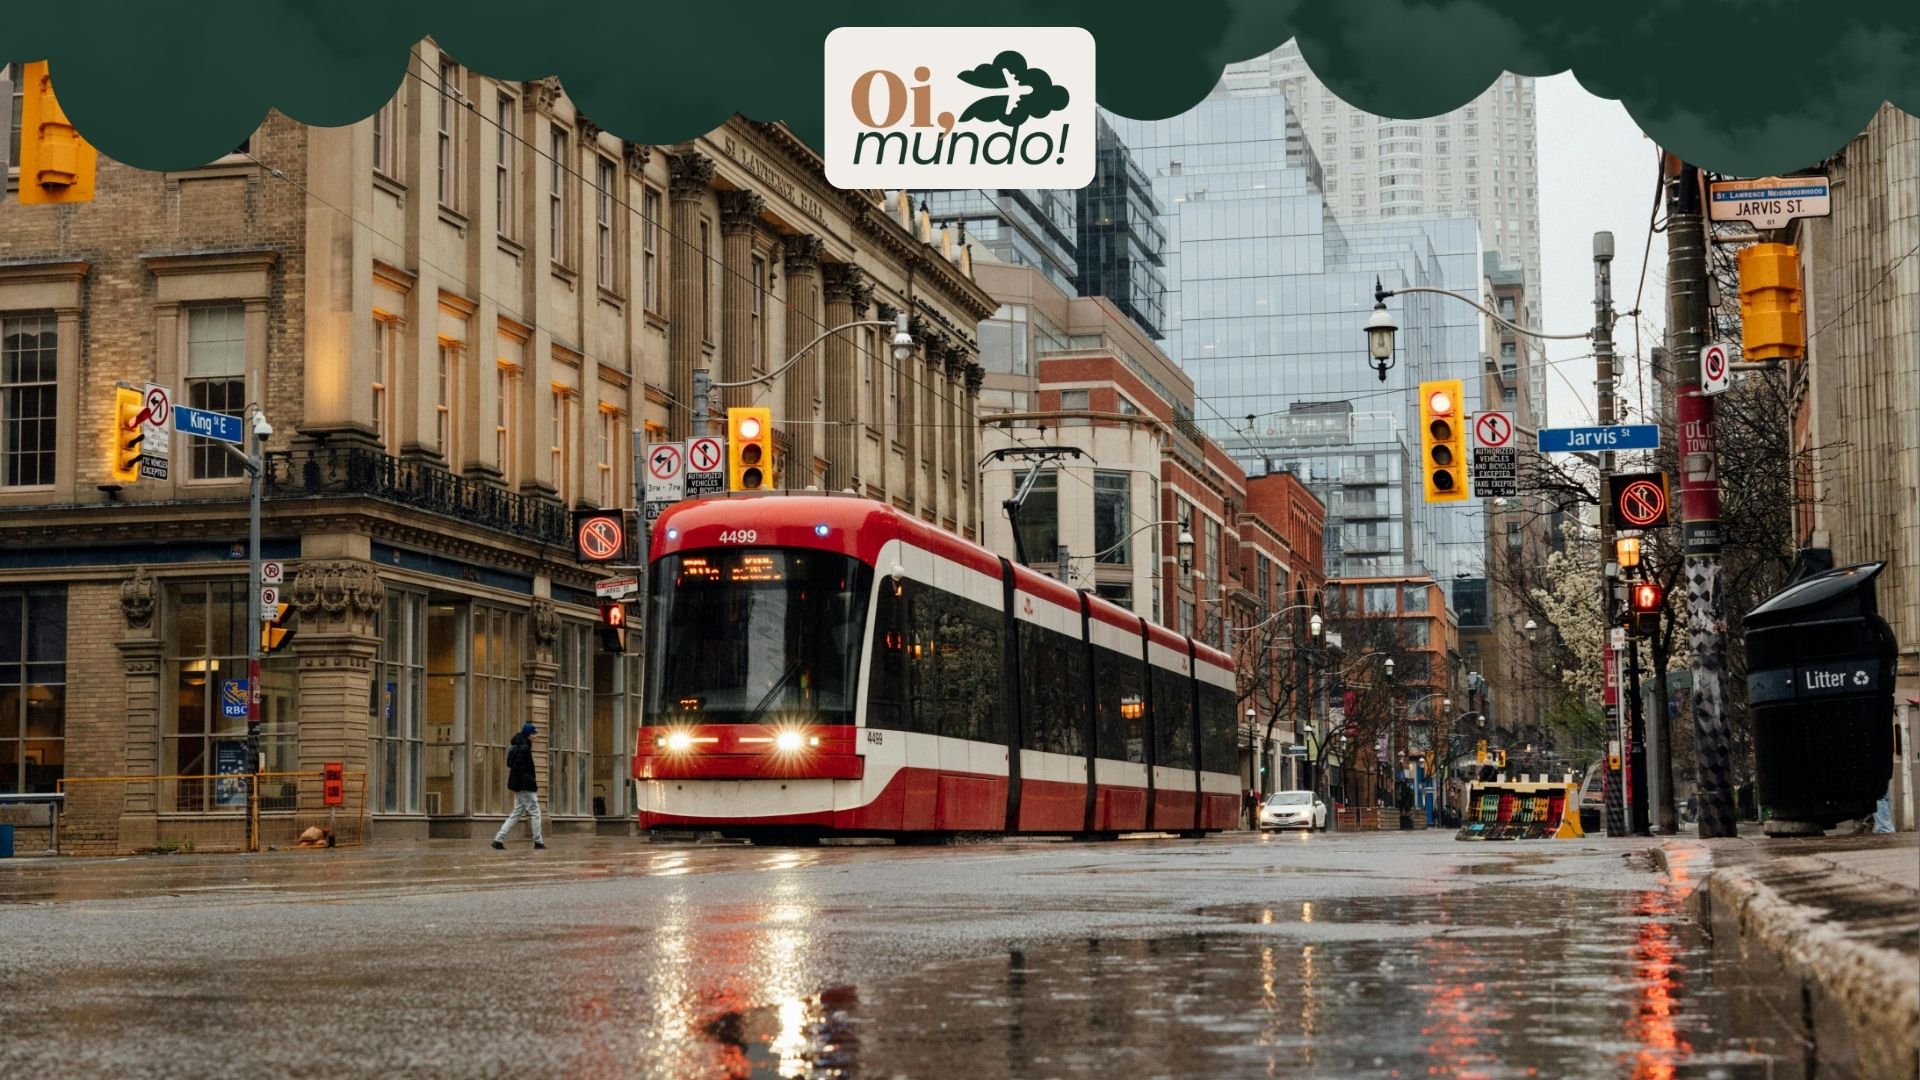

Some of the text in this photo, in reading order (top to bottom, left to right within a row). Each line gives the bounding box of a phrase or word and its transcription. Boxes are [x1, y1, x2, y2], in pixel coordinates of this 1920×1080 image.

[1736, 200, 1806, 216] JARVIS ST.
[190, 411, 227, 435] King St E
[1566, 428, 1631, 446] Jarvis St
[1686, 439, 1714, 452] TOWN
[143, 466, 167, 477] EXCEPTED
[719, 529, 757, 544] 4499
[1806, 670, 1846, 689] Litter
[226, 706, 248, 715] RBC
[867, 731, 883, 745] 4499
